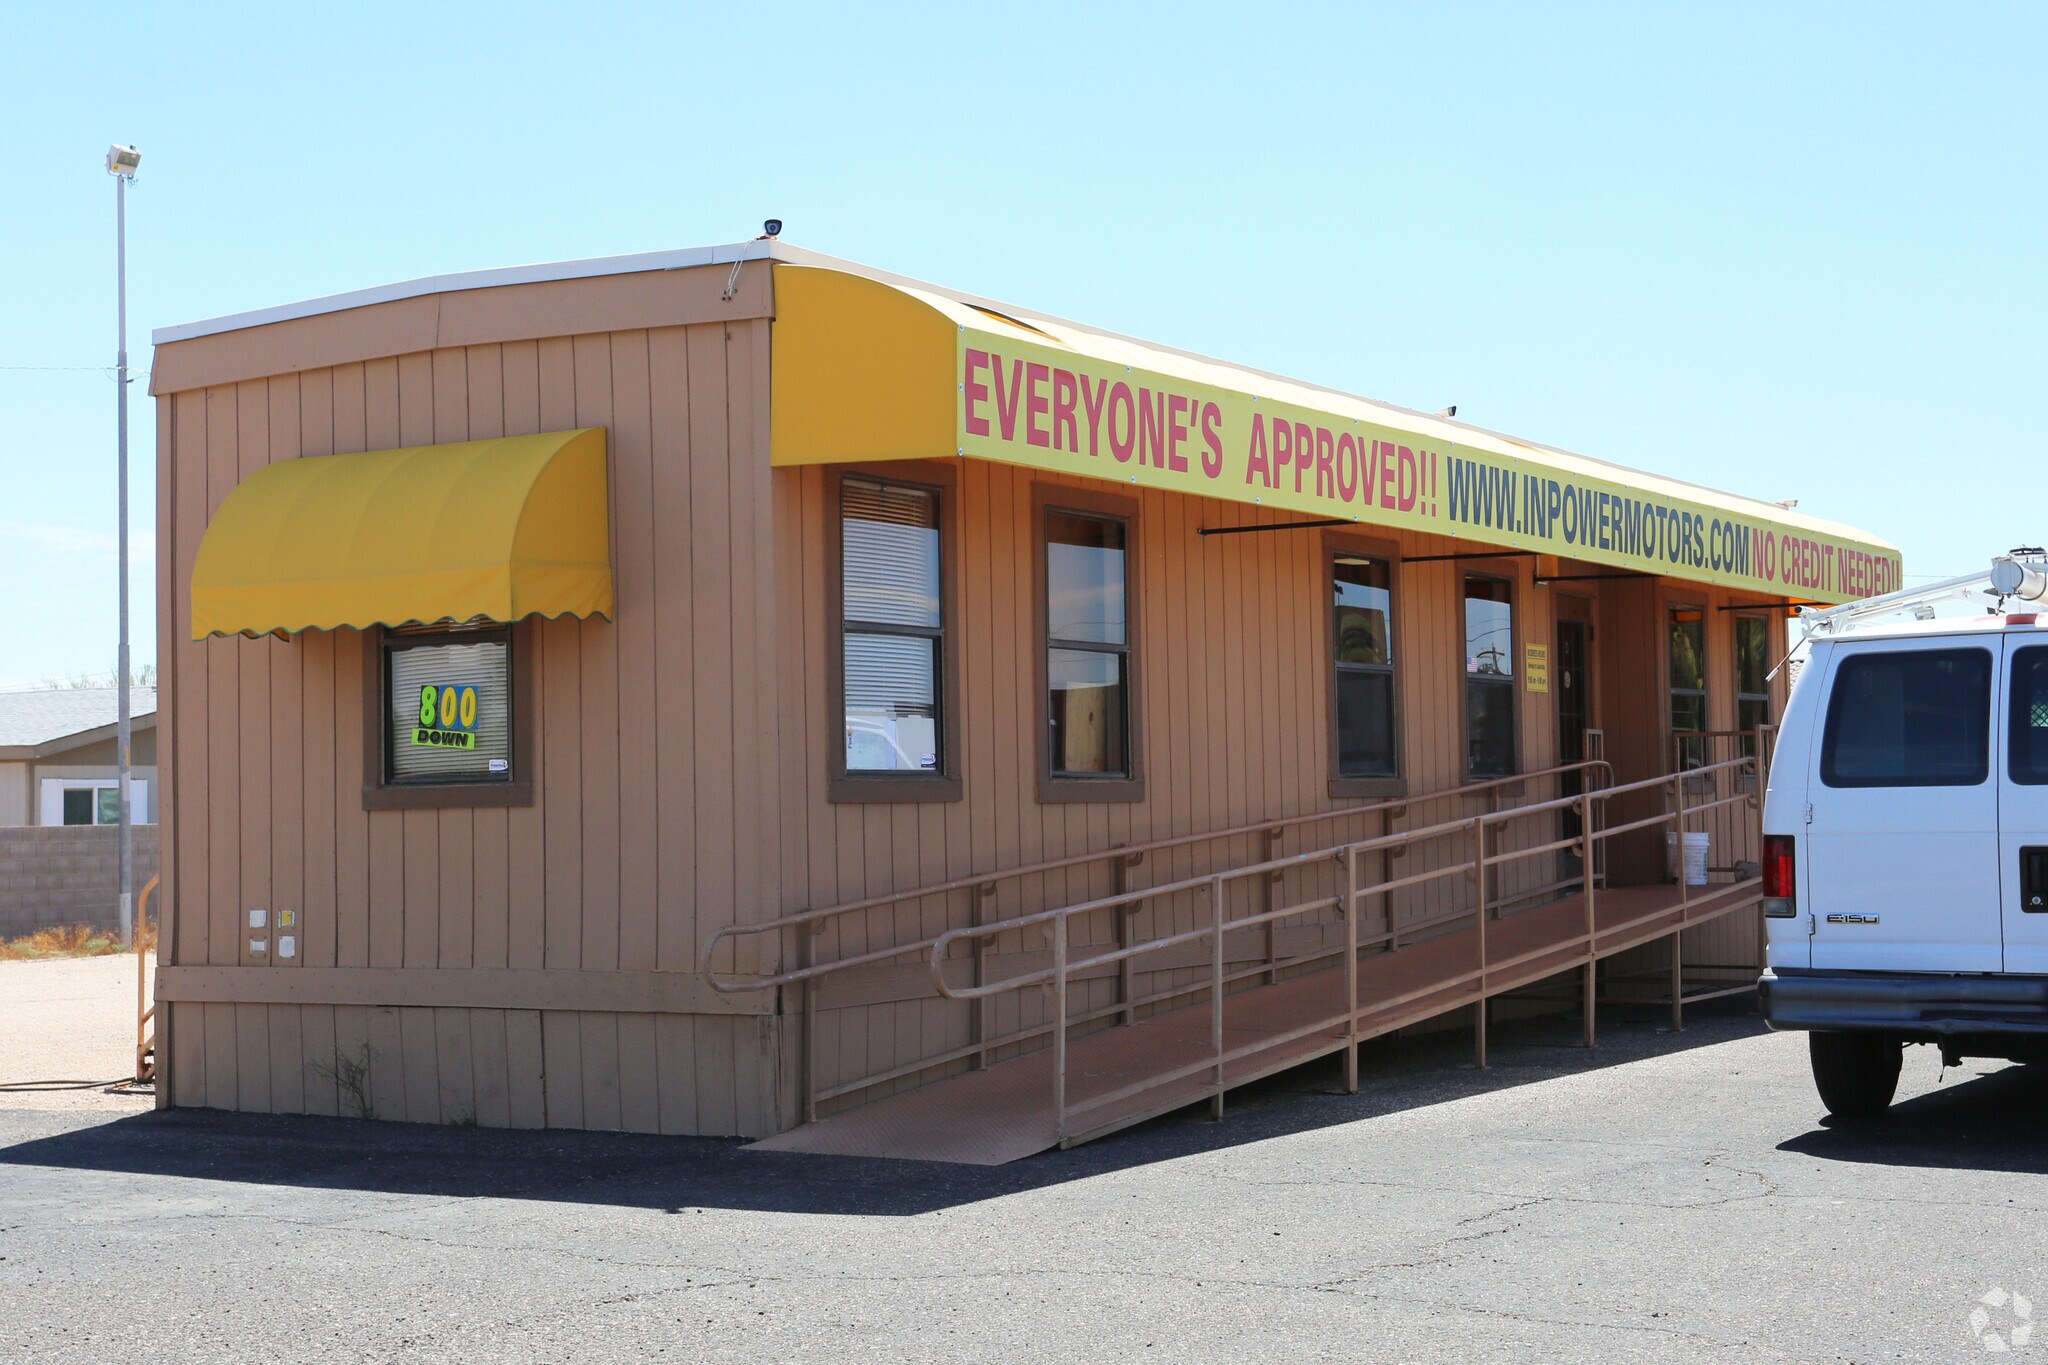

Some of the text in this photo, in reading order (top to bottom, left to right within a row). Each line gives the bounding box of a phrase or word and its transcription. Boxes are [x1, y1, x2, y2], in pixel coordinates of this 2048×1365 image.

[965, 348, 1223, 479] EVERYONE'S
[1246, 413, 1437, 518] APPROVED!!
[1447, 456, 1749, 576] WWW.INPOWERMOTORS.COM
[1753, 528, 1776, 581] NO
[1781, 536, 1834, 591] CREDIT
[420, 685, 477, 728] 800
[417, 729, 469, 747] DOWN
